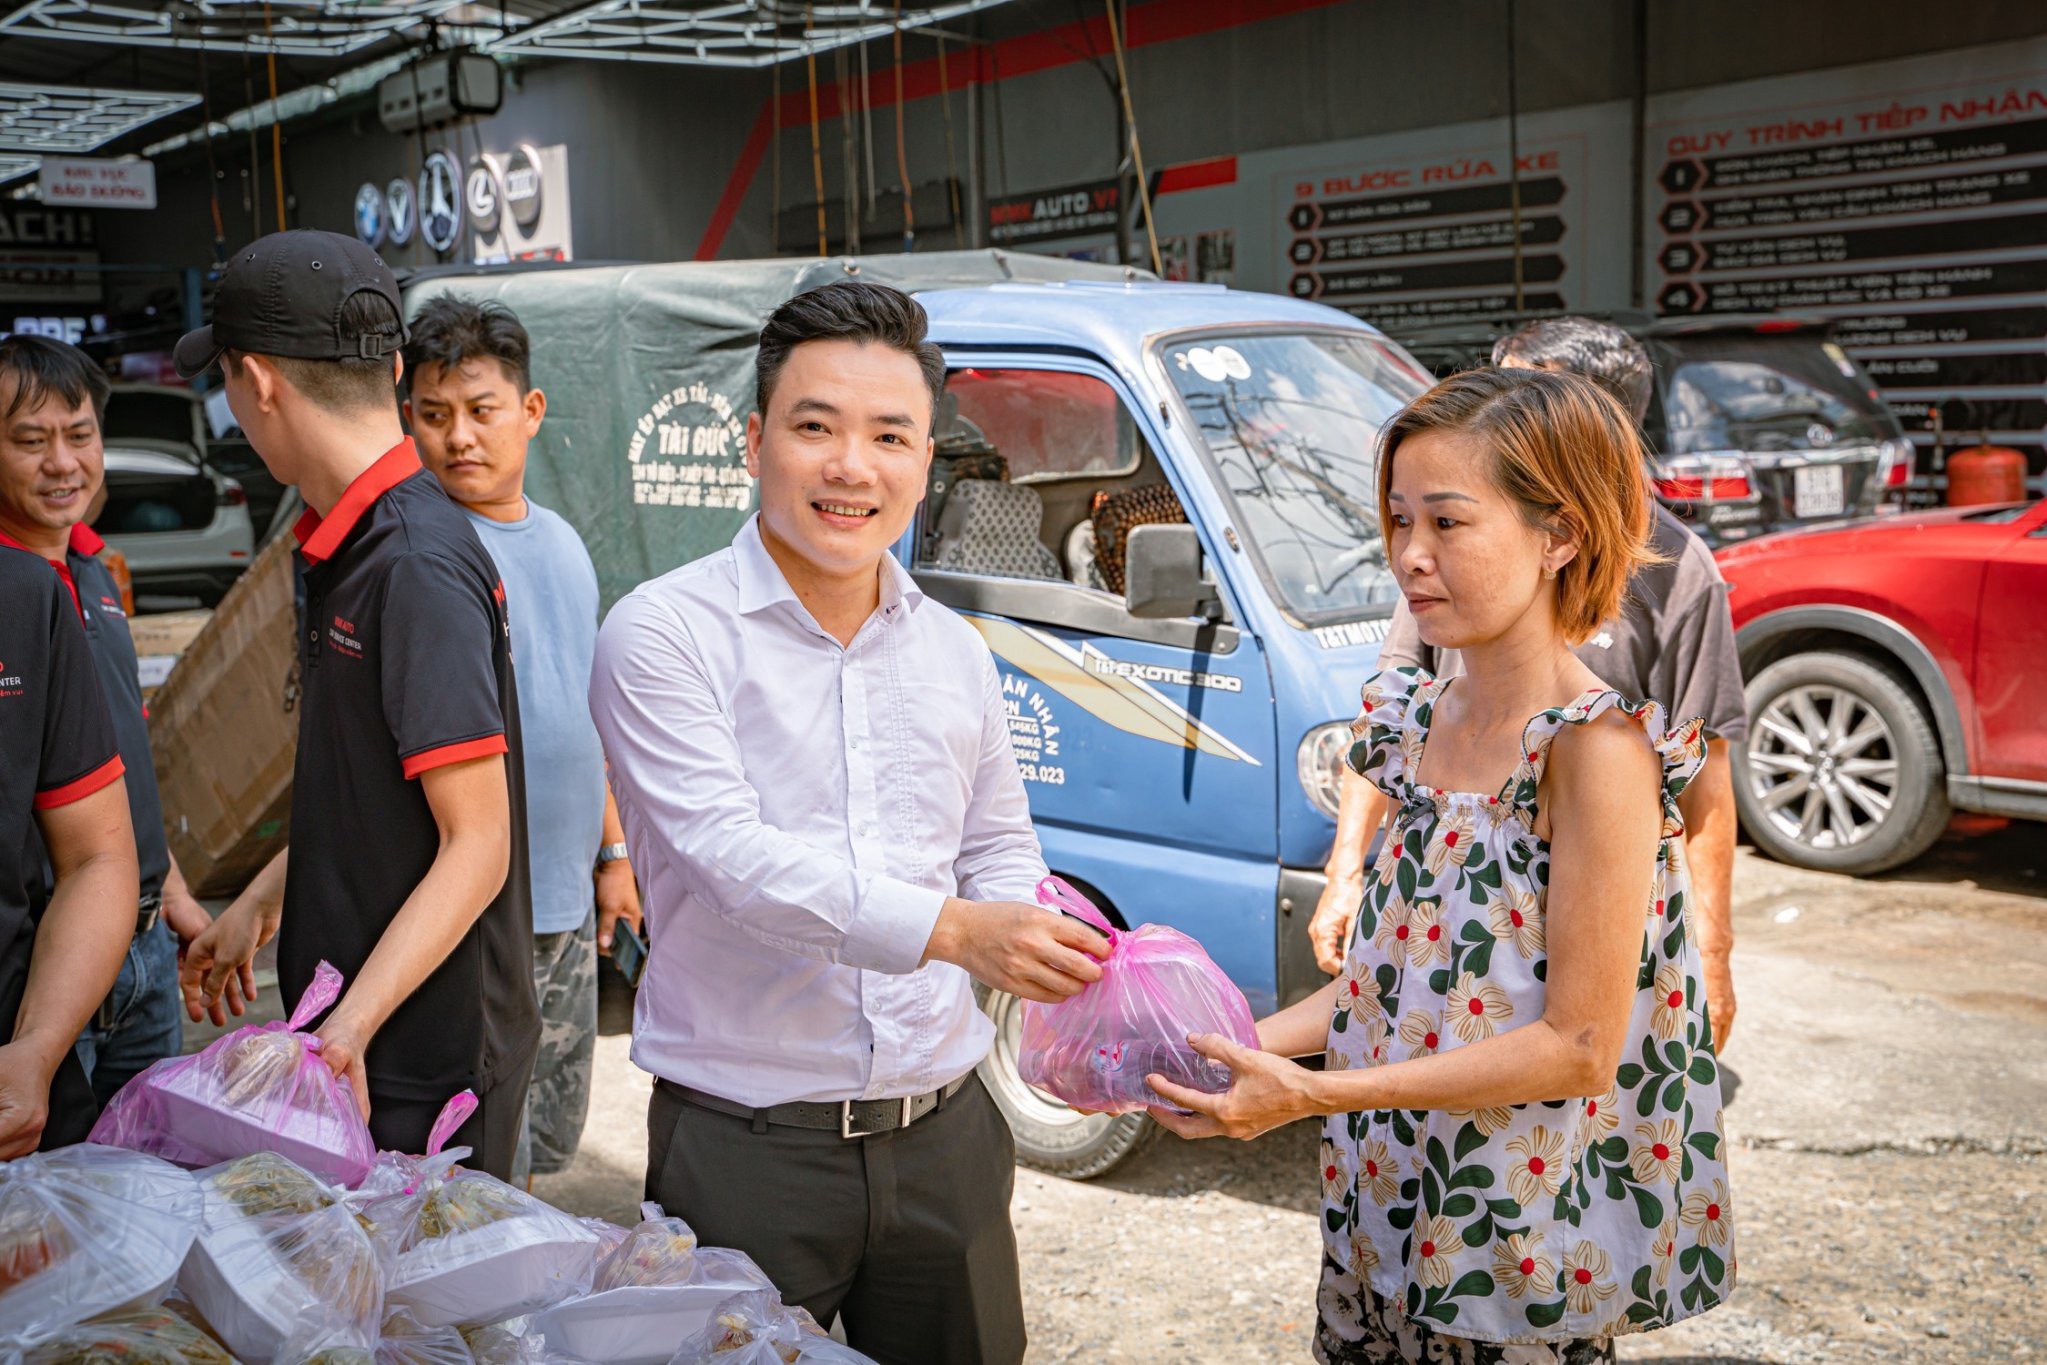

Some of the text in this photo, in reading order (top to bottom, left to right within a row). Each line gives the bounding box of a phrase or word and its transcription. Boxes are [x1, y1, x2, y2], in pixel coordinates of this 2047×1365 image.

[1666, 128, 1733, 156] QUY
[1745, 116, 1844, 145] TRÌNH
[1854, 100, 1929, 132] TIẾP
[1294, 181, 1314, 199] 9
[1515, 150, 1560, 172] XE
[0, 676, 22, 688] NTER
